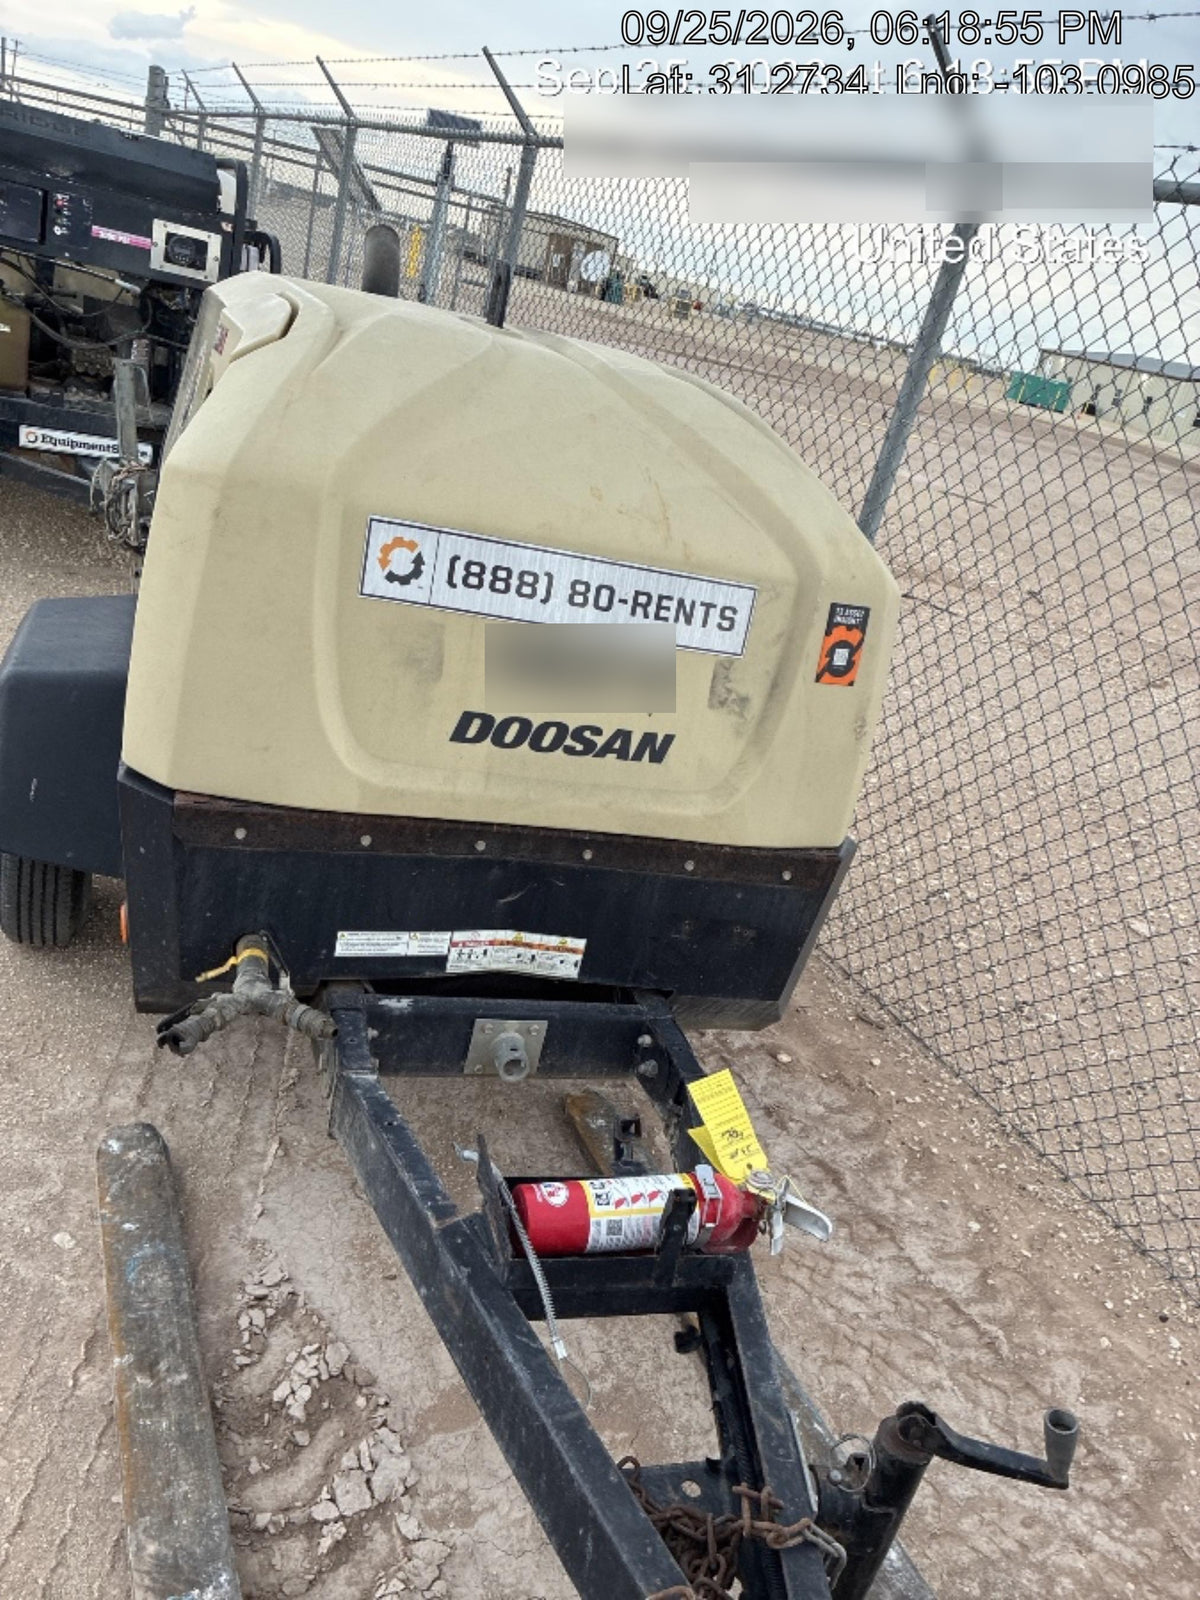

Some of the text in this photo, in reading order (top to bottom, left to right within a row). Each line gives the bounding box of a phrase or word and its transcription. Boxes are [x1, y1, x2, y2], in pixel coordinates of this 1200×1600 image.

[447, 554, 739, 632] (888) 80-RENTS
[448, 710, 676, 764] DOOSAN
